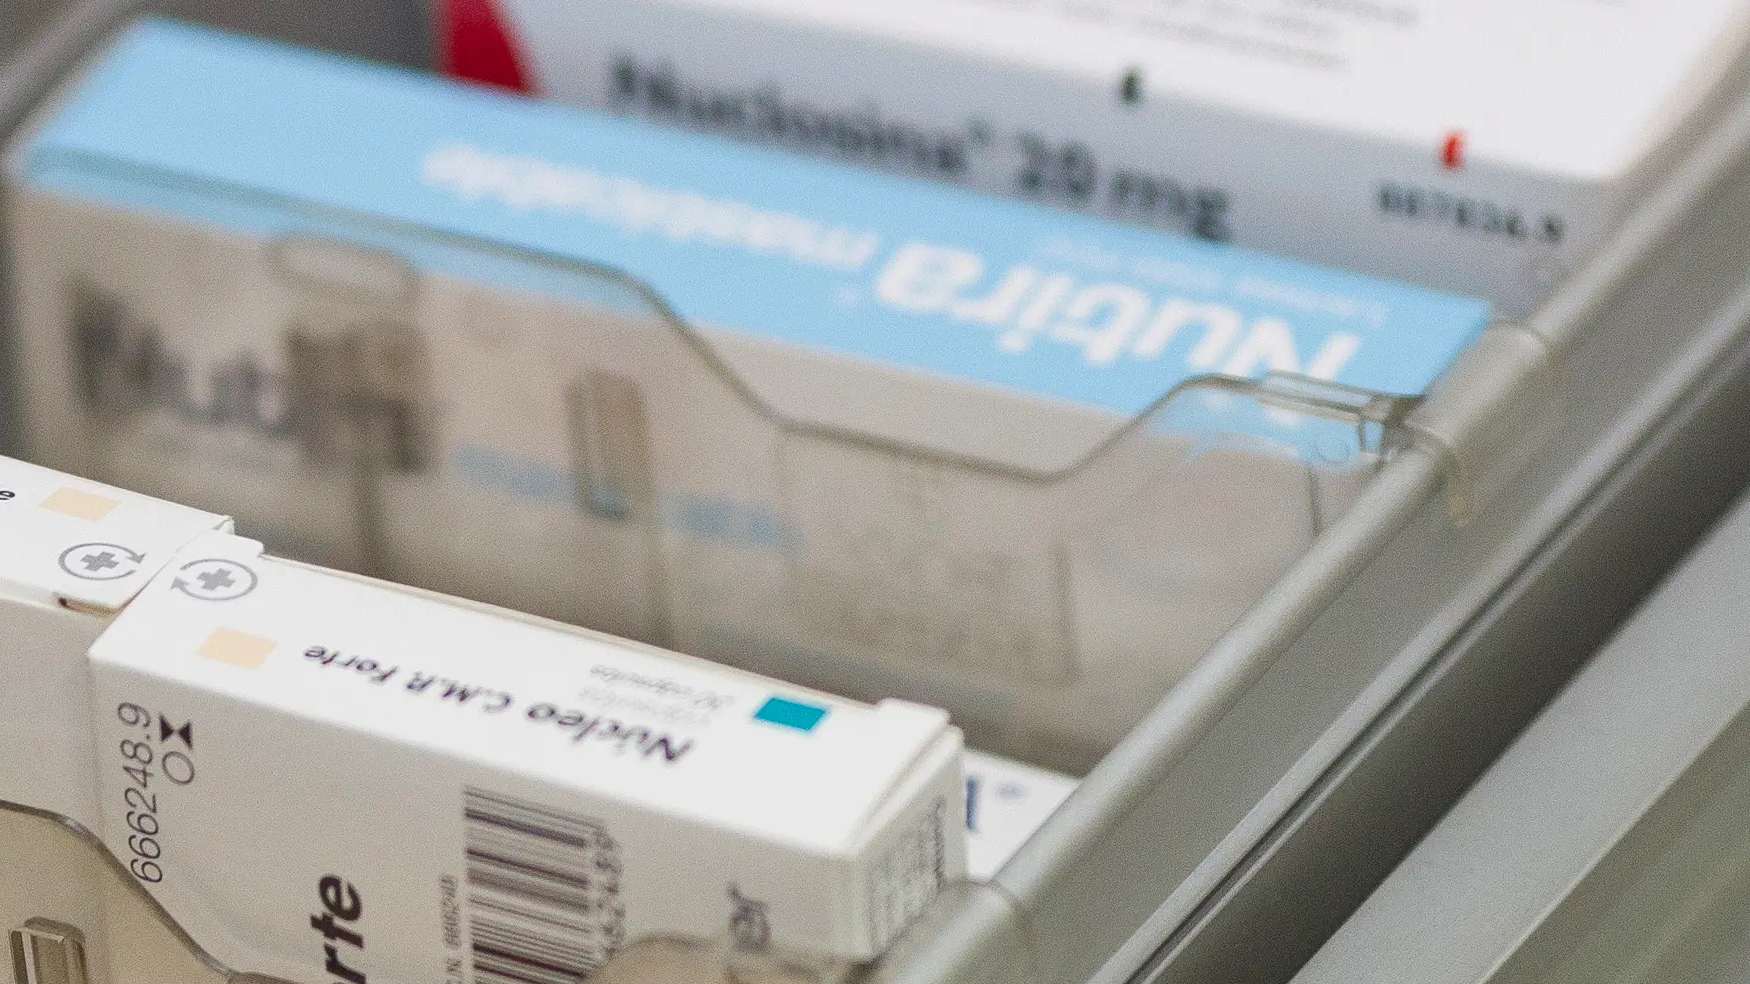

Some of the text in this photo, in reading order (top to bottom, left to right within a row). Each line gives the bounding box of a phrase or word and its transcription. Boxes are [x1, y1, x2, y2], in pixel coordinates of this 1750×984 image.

[303, 644, 398, 685] Forte
[526, 701, 691, 764] Núcleo
[117, 701, 163, 884] 666248.9
